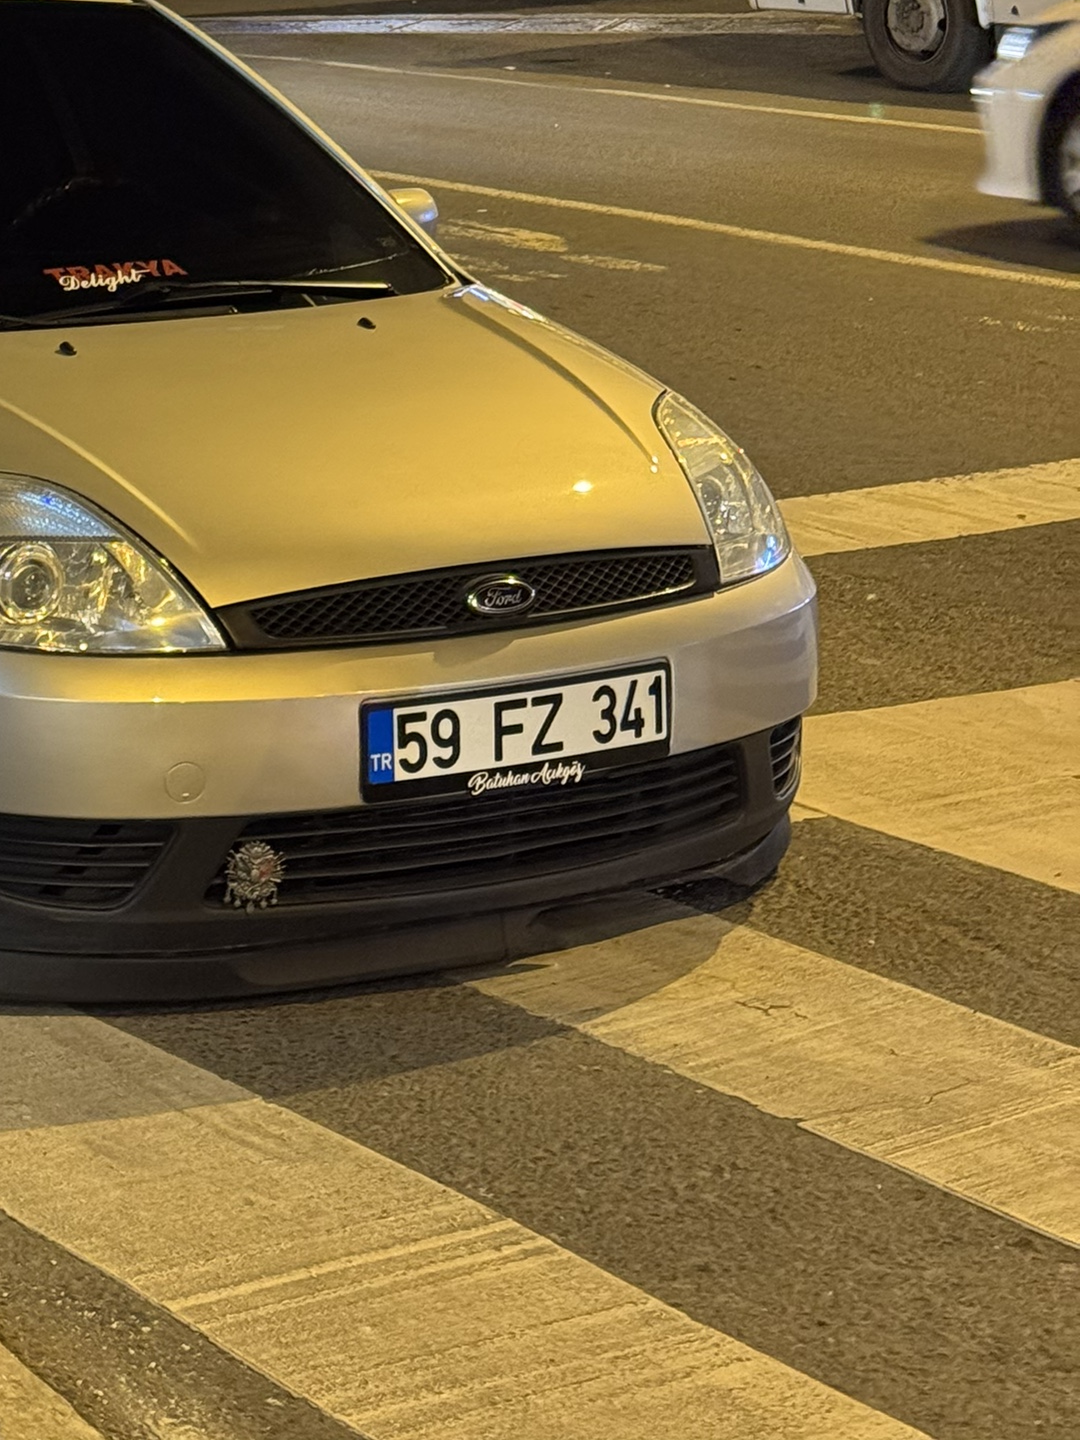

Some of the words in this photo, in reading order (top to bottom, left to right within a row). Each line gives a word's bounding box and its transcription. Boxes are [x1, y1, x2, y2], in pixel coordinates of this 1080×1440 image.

[59, 268, 150, 292] Delight
[484, 587, 522, 607] Ford
[370, 753, 392, 772] TR
[397, 709, 461, 774] 59
[494, 693, 564, 762] FZ
[592, 675, 662, 744] 341
[467, 771, 531, 796] Batuhan
